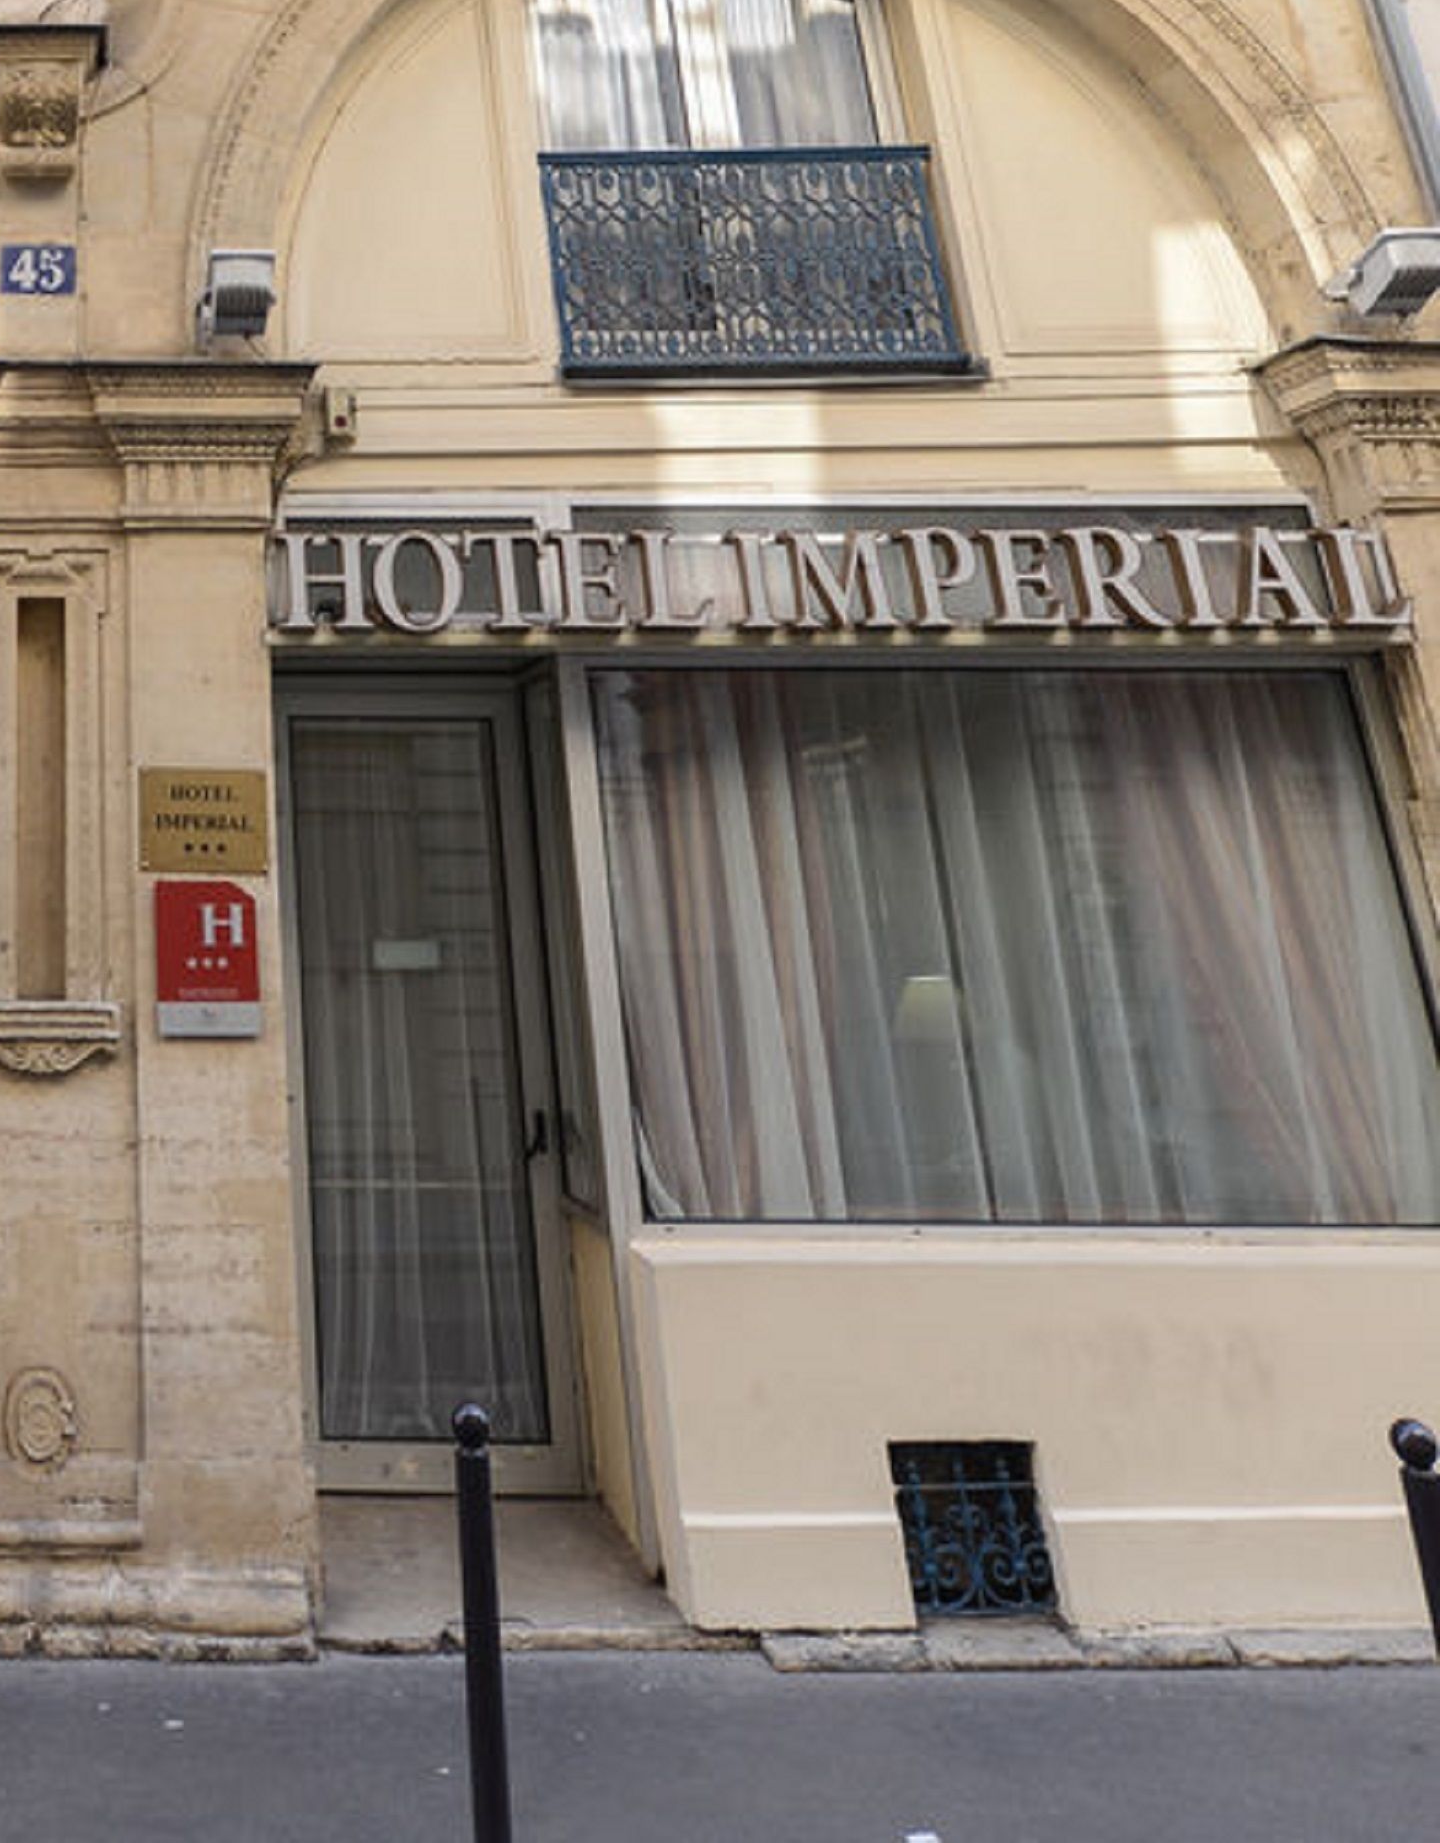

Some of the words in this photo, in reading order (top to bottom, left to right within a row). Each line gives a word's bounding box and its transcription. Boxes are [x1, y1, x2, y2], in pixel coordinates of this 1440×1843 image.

[8, 248, 65, 291] 45
[270, 529, 714, 635] HOTEL
[723, 526, 1412, 630] IMPERIAL
[170, 785, 239, 802] HOTEL
[202, 903, 244, 947] H
